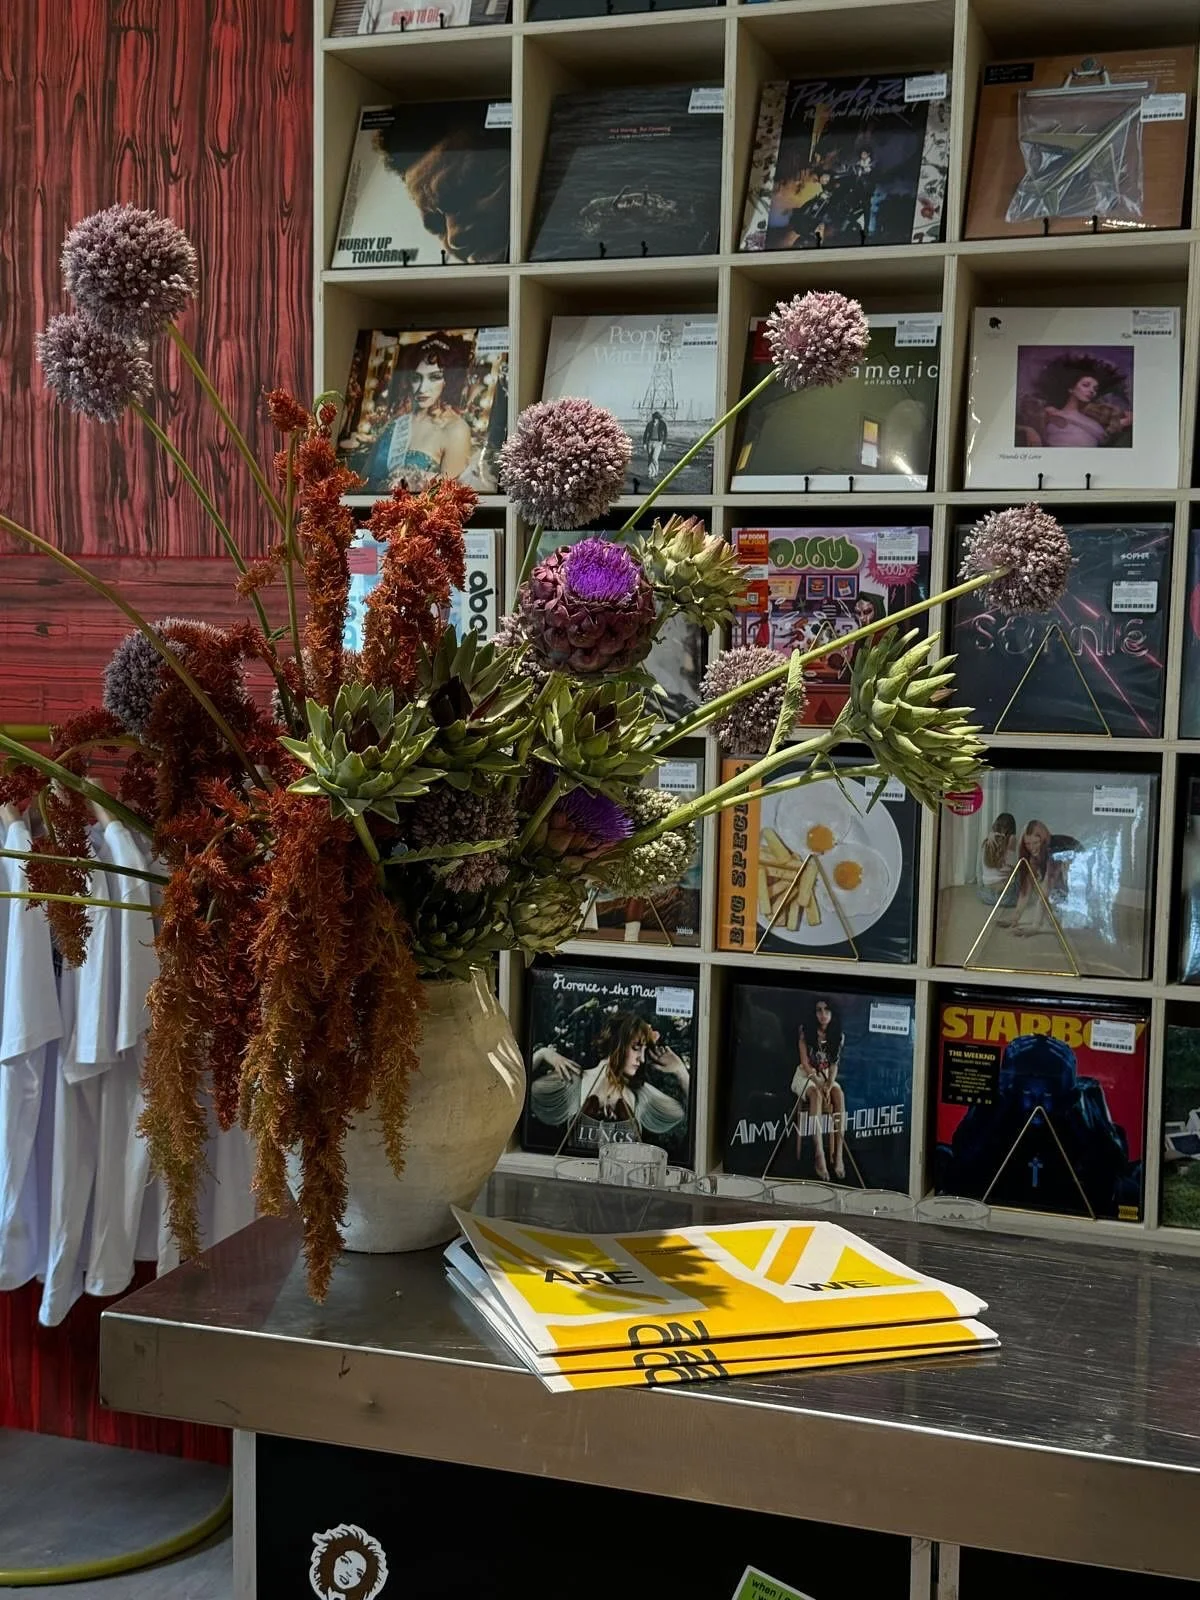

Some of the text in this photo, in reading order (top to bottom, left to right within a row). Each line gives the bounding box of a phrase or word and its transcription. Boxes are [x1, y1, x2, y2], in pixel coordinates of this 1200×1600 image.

[416, 9, 427, 24] TO
[338, 237, 392, 251] HURRY UP
[609, 325, 672, 351] People
[851, 361, 939, 379] americ
[730, 895, 746, 946] BIG
[553, 972, 600, 994] Florence
[608, 984, 629, 996] the
[578, 1127, 634, 1143] LUNGS
[730, 1119, 780, 1146] AMY
[544, 1269, 644, 1285] ARE
[790, 1279, 881, 1292] WE
[628, 1319, 709, 1346] ON
[752, 1580, 776, 1597] when
